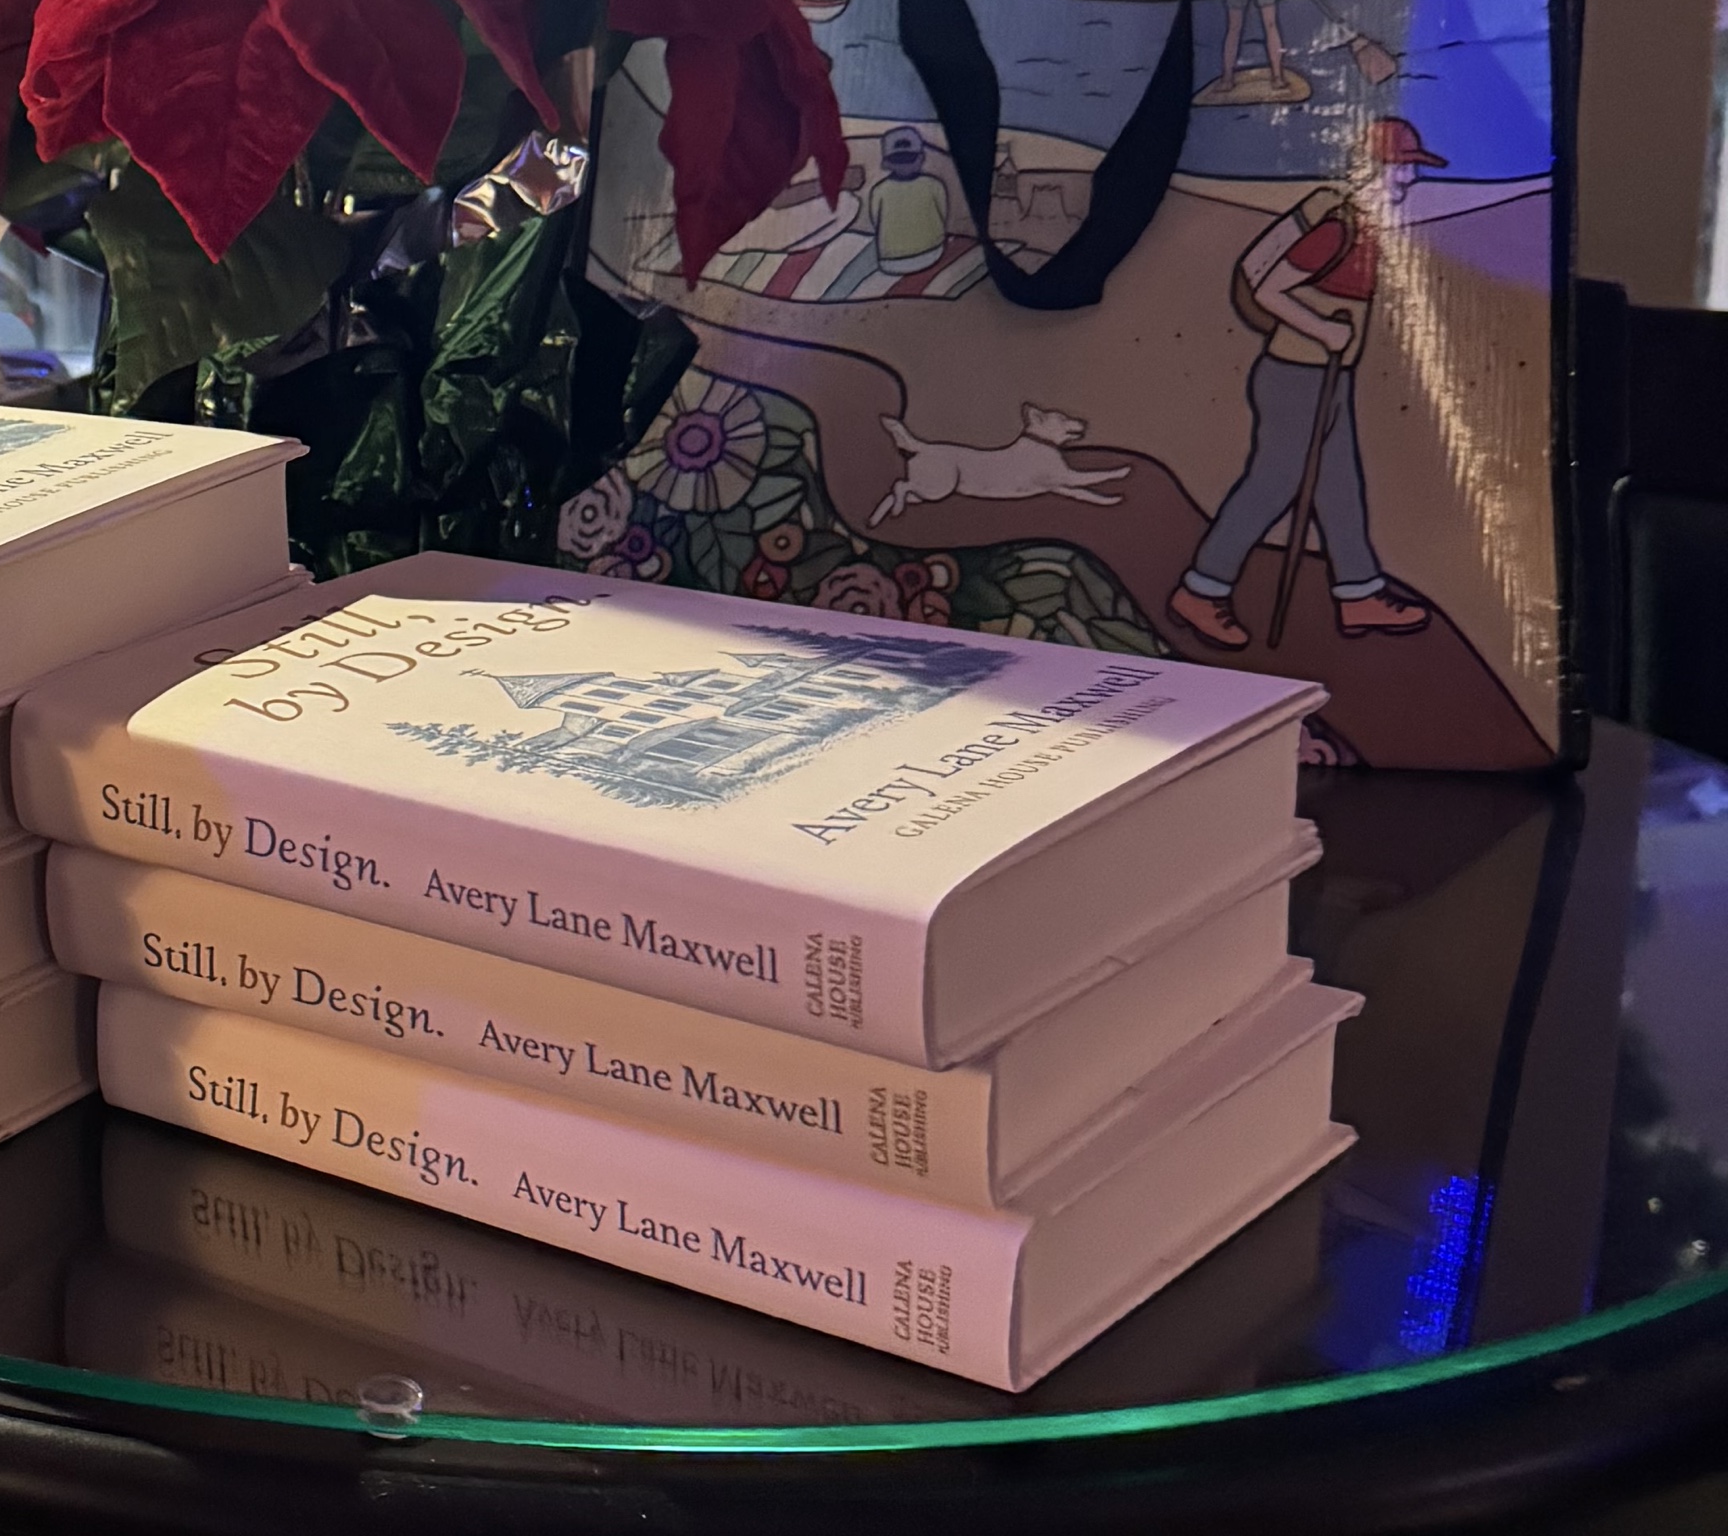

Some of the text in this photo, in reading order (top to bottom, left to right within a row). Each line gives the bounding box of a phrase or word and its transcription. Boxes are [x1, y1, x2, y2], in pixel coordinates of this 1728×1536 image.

[22, 430, 174, 479] Maxwell
[193, 605, 437, 680] Still,
[223, 592, 612, 723] by Design.
[791, 664, 1163, 846] Avery Lane Maxwell
[894, 697, 1178, 838] GALENA HOUSE PUBLISHING
[101, 784, 780, 984] Still, by Design. Avery Lane Maxwell
[143, 932, 844, 1134] Still, by Design. Avery Lane Maxwell
[827, 939, 848, 1021] HOUSE
[188, 1065, 868, 1306] Still, by Design. Avery Lane Maxwell
[892, 1093, 910, 1169] HOUSE
[916, 1267, 937, 1346] HOUSE
